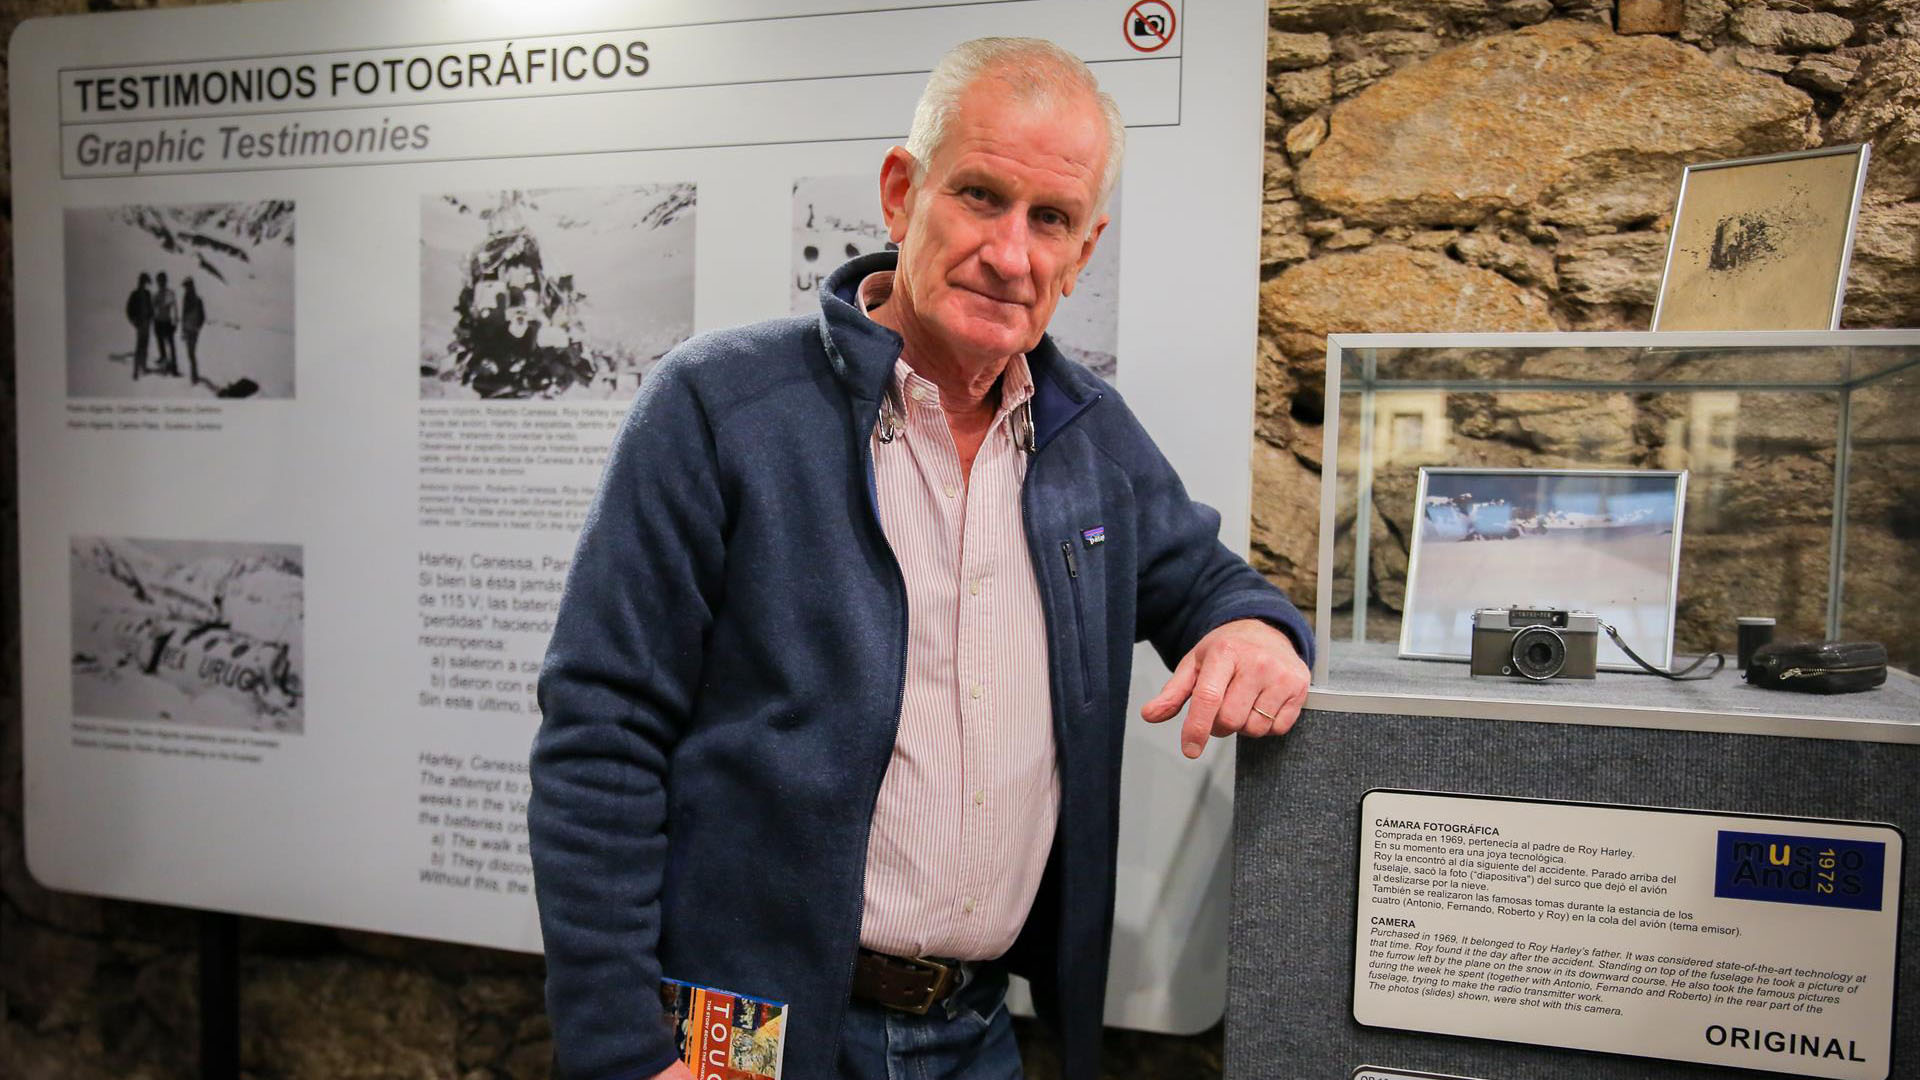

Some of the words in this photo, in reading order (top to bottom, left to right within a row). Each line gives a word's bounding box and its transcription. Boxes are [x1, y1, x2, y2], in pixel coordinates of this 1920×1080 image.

[75, 66, 316, 112] TESTIMONIOS
[331, 40, 650, 97] FOTOGRÁFICOS
[76, 127, 206, 174] Graphic
[220, 117, 430, 160] Testimonies
[1374, 829, 1423, 843] Comprada
[1532, 842, 1560, 852] padre
[1577, 844, 1598, 857] Roy
[1375, 817, 1421, 830] CÁMARA
[1423, 822, 1500, 836] FOTOGRÁFICA
[1373, 851, 1393, 862] Roy
[1476, 859, 1519, 872] siguiente
[1521, 862, 1537, 873] del
[1591, 868, 1627, 880] Parado
[1629, 873, 1658, 883] arriba
[1660, 874, 1677, 884] del
[1403, 842, 1447, 855] momento
[1448, 845, 1465, 856] era
[1466, 846, 1485, 858] una
[1486, 848, 1507, 860] joya
[1382, 874, 1430, 886] deslizarse
[1432, 878, 1449, 889] por
[1449, 868, 1468, 878] foto
[1536, 875, 1552, 885] del
[1554, 876, 1582, 888] surco
[1583, 881, 1603, 890] que
[1639, 884, 1667, 895] avión
[1817, 848, 1836, 894] 1972
[1371, 896, 1401, 905] cuatro
[1497, 905, 1536, 917] Roberto
[1546, 909, 1570, 922] Roy)
[1598, 915, 1619, 925] cola
[1621, 916, 1637, 927] del
[1639, 918, 1667, 929] avión
[1669, 921, 1699, 932] (tema
[1372, 883, 1411, 895] También
[1427, 887, 1473, 901] realizaron
[1475, 892, 1489, 903] las
[1491, 893, 1533, 906] famosas
[1534, 898, 1565, 909] tomas
[1566, 900, 1605, 912] durante
[1618, 905, 1660, 917] estancia
[1678, 910, 1694, 920] los
[1370, 916, 1416, 928] CAMERA
[1369, 938, 1388, 948] that
[1414, 942, 1434, 955] Roy
[1435, 943, 1463, 955] found
[1488, 950, 1508, 961] day
[1509, 951, 1533, 962] after
[1598, 959, 1642, 974] Standing
[1659, 966, 1677, 977] top
[1690, 968, 1709, 979] the
[1709, 970, 1754, 984] fuselage
[1772, 977, 1796, 988] took
[1806, 980, 1845, 993] picture
[1370, 927, 1421, 940] Purchased
[1469, 936, 1515, 950] belonged
[1527, 941, 1548, 954] Roy
[1634, 953, 1655, 963] was
[1657, 955, 1714, 968] considered
[1715, 961, 1793, 976] state-of-the-art
[1794, 968, 1854, 983] technology
[1368, 959, 1399, 973] during
[1416, 963, 1442, 975] week
[1456, 967, 1485, 980] spent
[1486, 970, 1531, 985] (together
[1531, 976, 1552, 986] with
[1595, 982, 1645, 996] Fernando
[1645, 988, 1666, 998] and
[1667, 989, 1712, 1004] Roberto)
[1726, 994, 1743, 1006] the
[1745, 999, 1768, 1008] rear
[1768, 1001, 1791, 1011] part
[1385, 950, 1416, 961] furrow
[1416, 953, 1432, 963] left
[1463, 958, 1492, 971] plane
[1507, 962, 1524, 972] the
[1525, 963, 1552, 975] snow
[1564, 967, 1577, 978] its
[1578, 968, 1631, 983] downward
[1688, 979, 1710, 991] also
[1712, 982, 1735, 993] took
[1755, 986, 1796, 999] famous
[1796, 990, 1841, 1004] pictures
[1412, 974, 1438, 988] trying
[1451, 977, 1478, 990] make
[1497, 982, 1522, 994] radio
[1523, 986, 1577, 999] transmitter
[1369, 981, 1386, 991] The
[1387, 983, 1420, 995] photos
[1421, 986, 1455, 1000] (slides)
[1493, 996, 1517, 1005] were
[1519, 997, 1541, 1007] shot
[1542, 997, 1562, 1009] with
[1564, 1001, 1582, 1012] this
[1705, 1025, 1866, 1062] ORIGINAL
